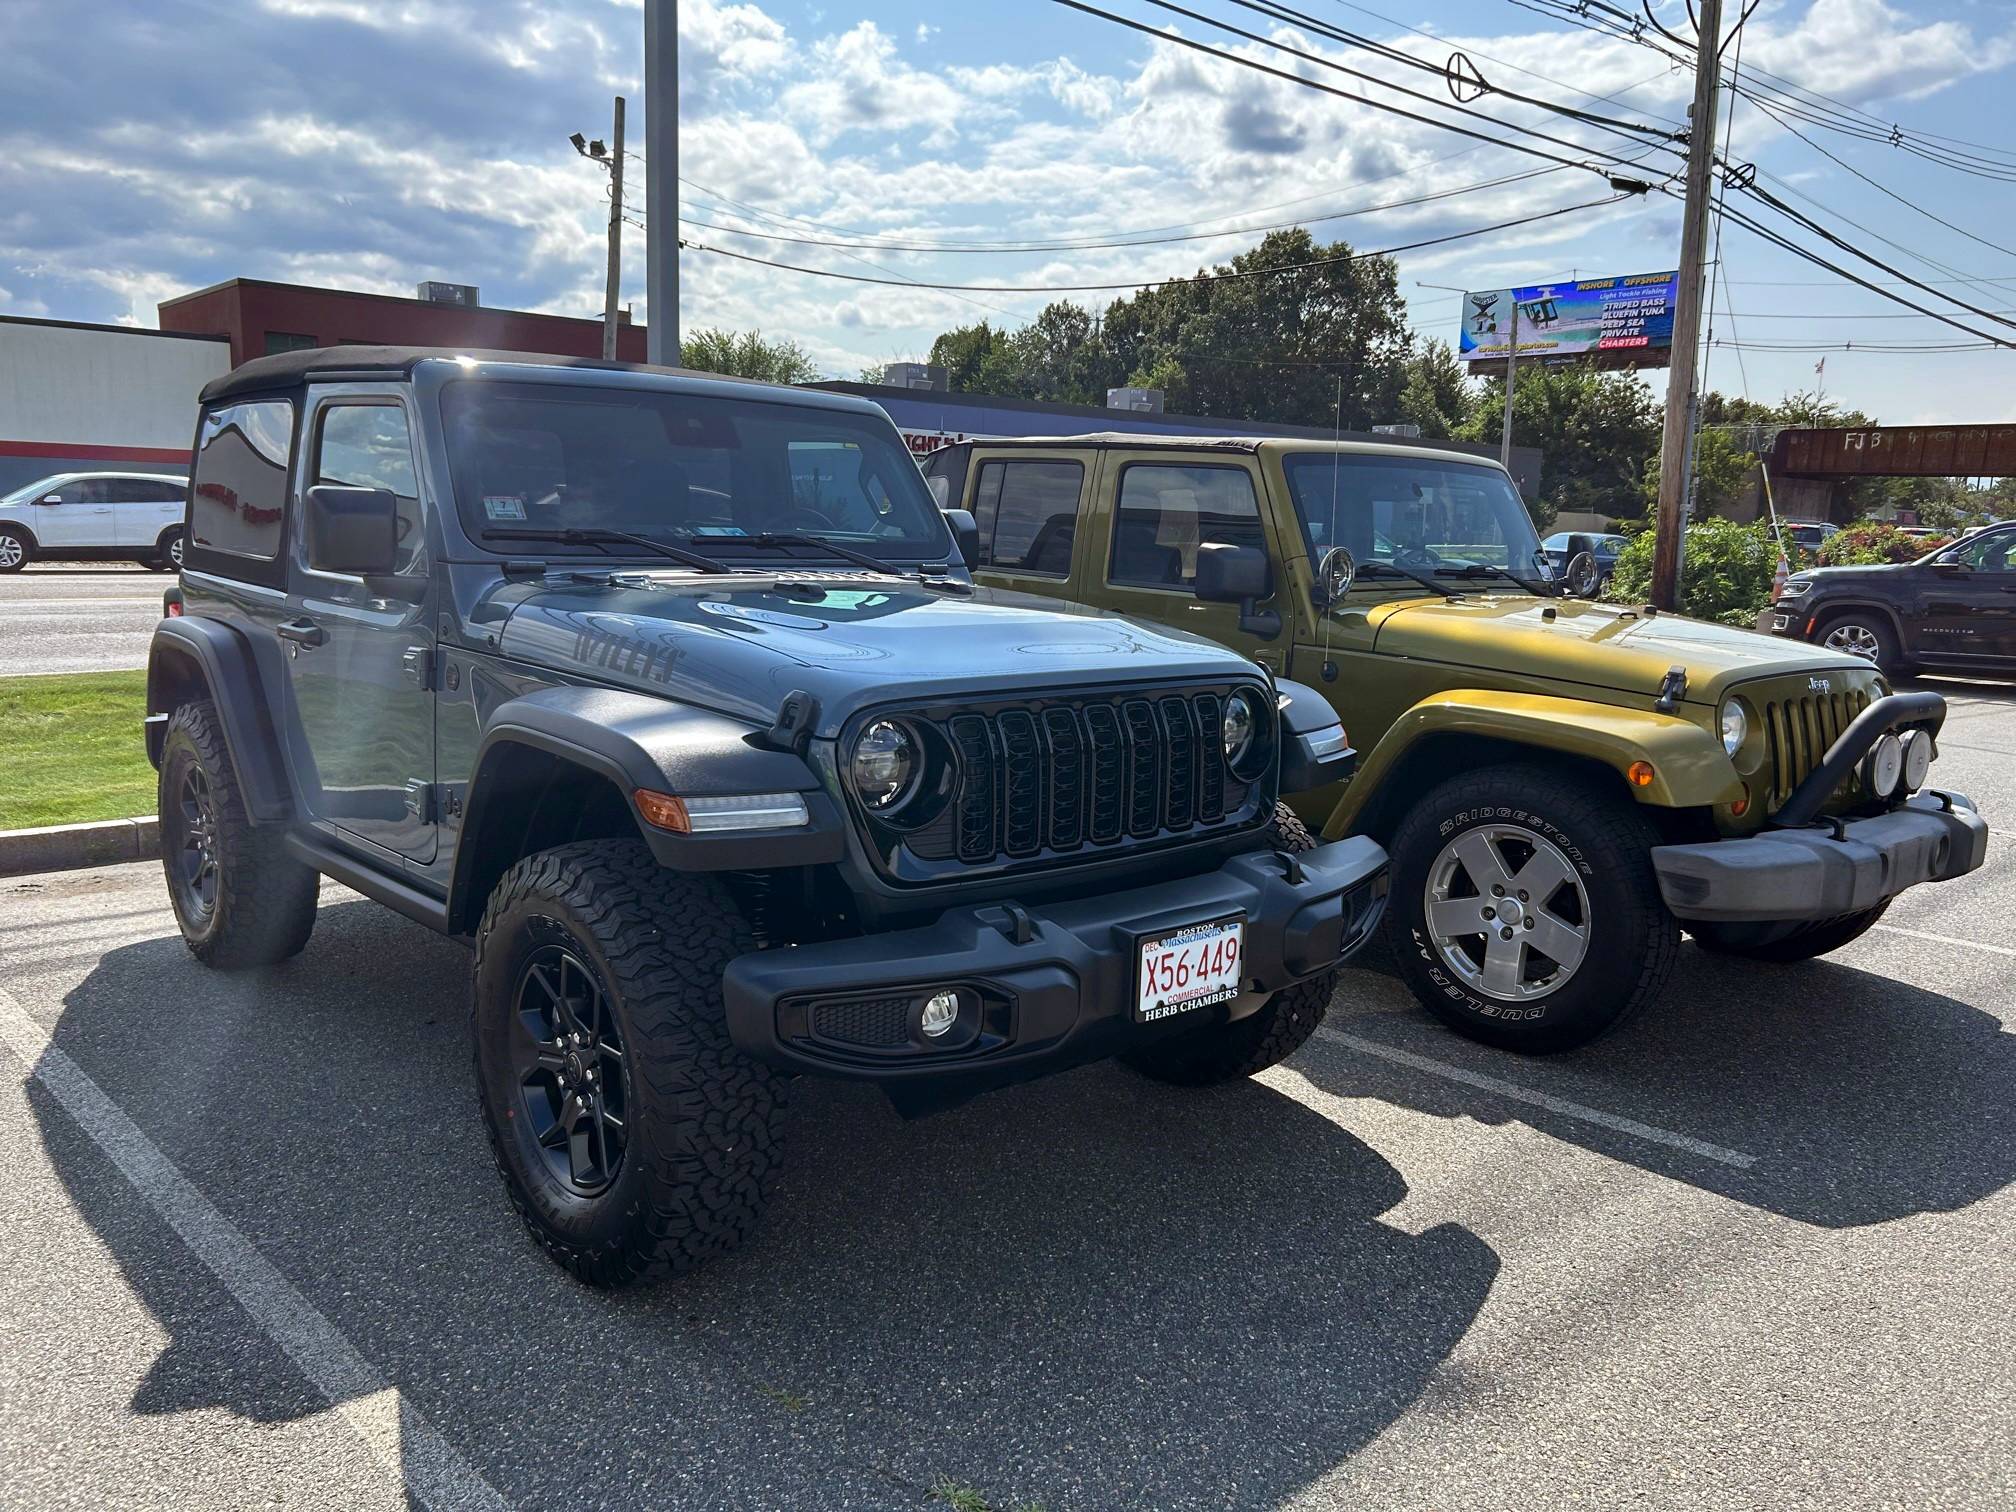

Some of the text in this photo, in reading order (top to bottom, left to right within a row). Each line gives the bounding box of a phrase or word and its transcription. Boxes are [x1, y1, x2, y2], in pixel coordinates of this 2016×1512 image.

[1577, 280, 1615, 291] INSHORE
[1624, 274, 1672, 286] OFFSHORE
[1641, 288, 1667, 296] Fishing
[1603, 298, 1665, 311] STRIPED BASS
[1602, 307, 1665, 320] BLUEFIN TUNA
[1601, 318, 1645, 329] DEEP SEA
[1600, 328, 1640, 338] PRIVATE
[1599, 337, 1648, 349] CHARTERS
[1808, 677, 1830, 695] Jeep
[1439, 806, 1593, 876] BRIDGESTONE
[1177, 922, 1215, 937] BOSTON
[1144, 941, 1159, 953] DEC
[1167, 984, 1215, 1004] COMMERCIAL
[1145, 988, 1238, 1022] HERB CHAMBERS
